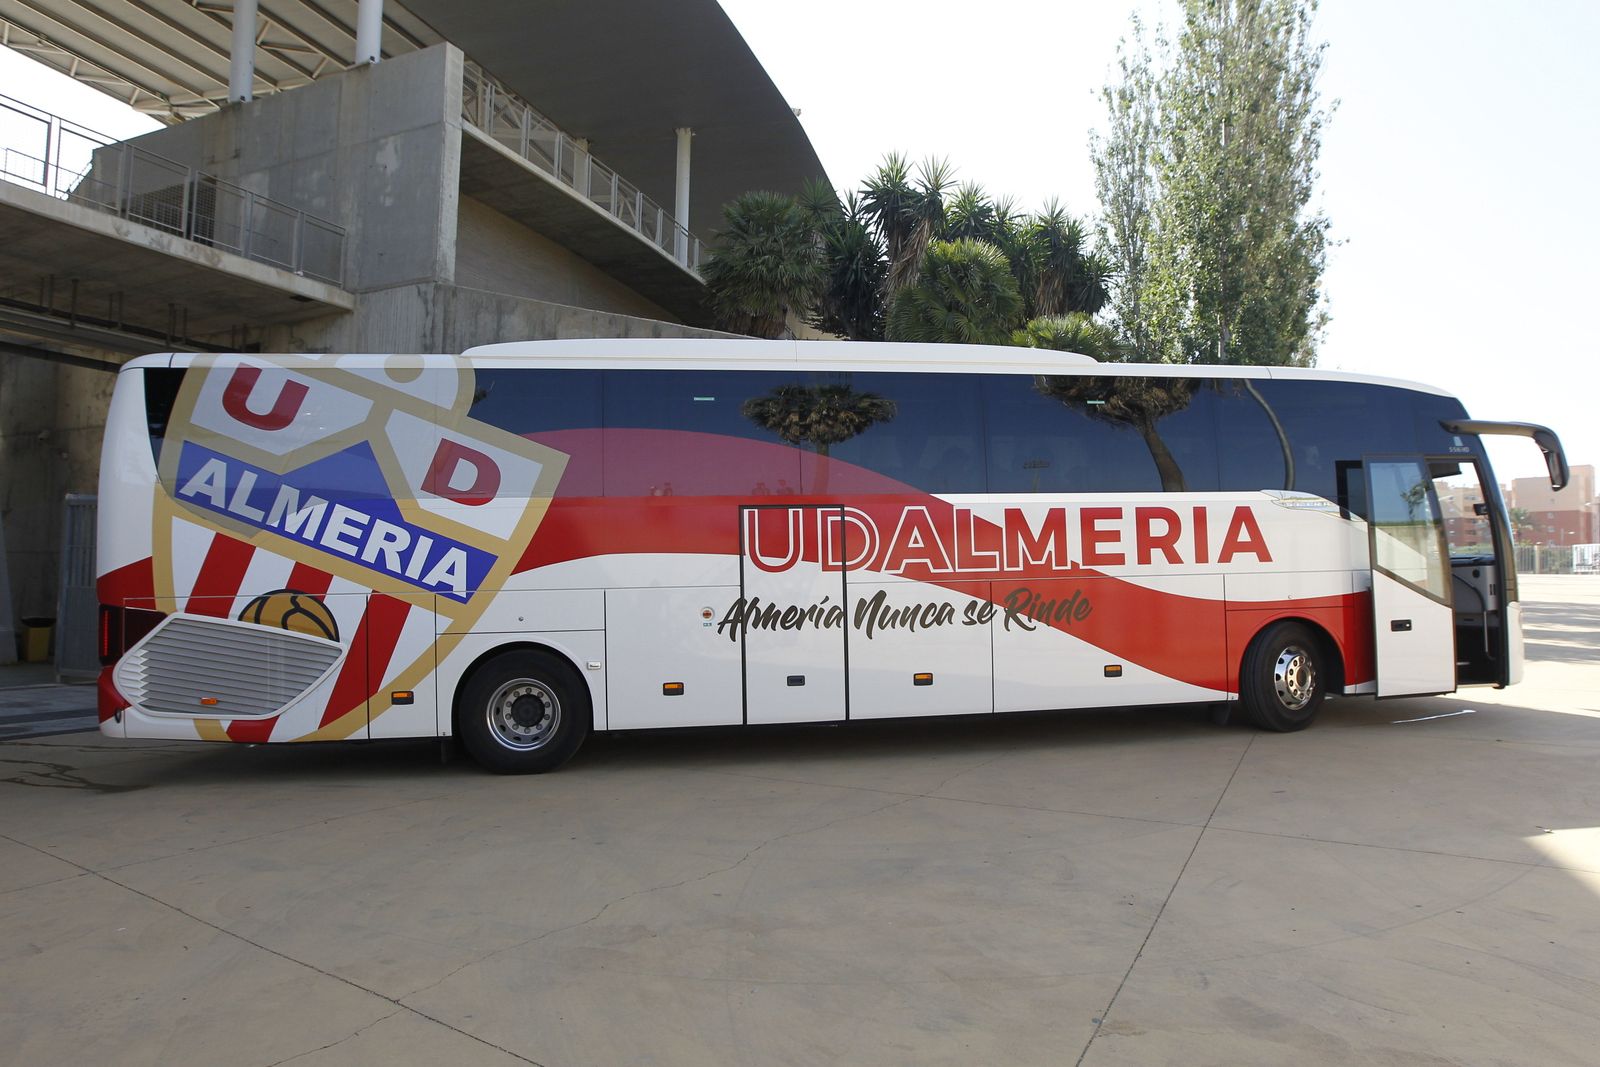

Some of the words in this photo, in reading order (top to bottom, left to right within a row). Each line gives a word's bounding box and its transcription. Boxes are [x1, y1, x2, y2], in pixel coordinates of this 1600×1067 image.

[222, 363, 310, 432] U
[420, 437, 502, 507] D
[178, 457, 468, 599] ALMERIA
[717, 595, 845, 643] Almería
[853, 589, 956, 640] Nunca
[961, 600, 998, 627] se
[1003, 587, 1093, 632] Rinde
